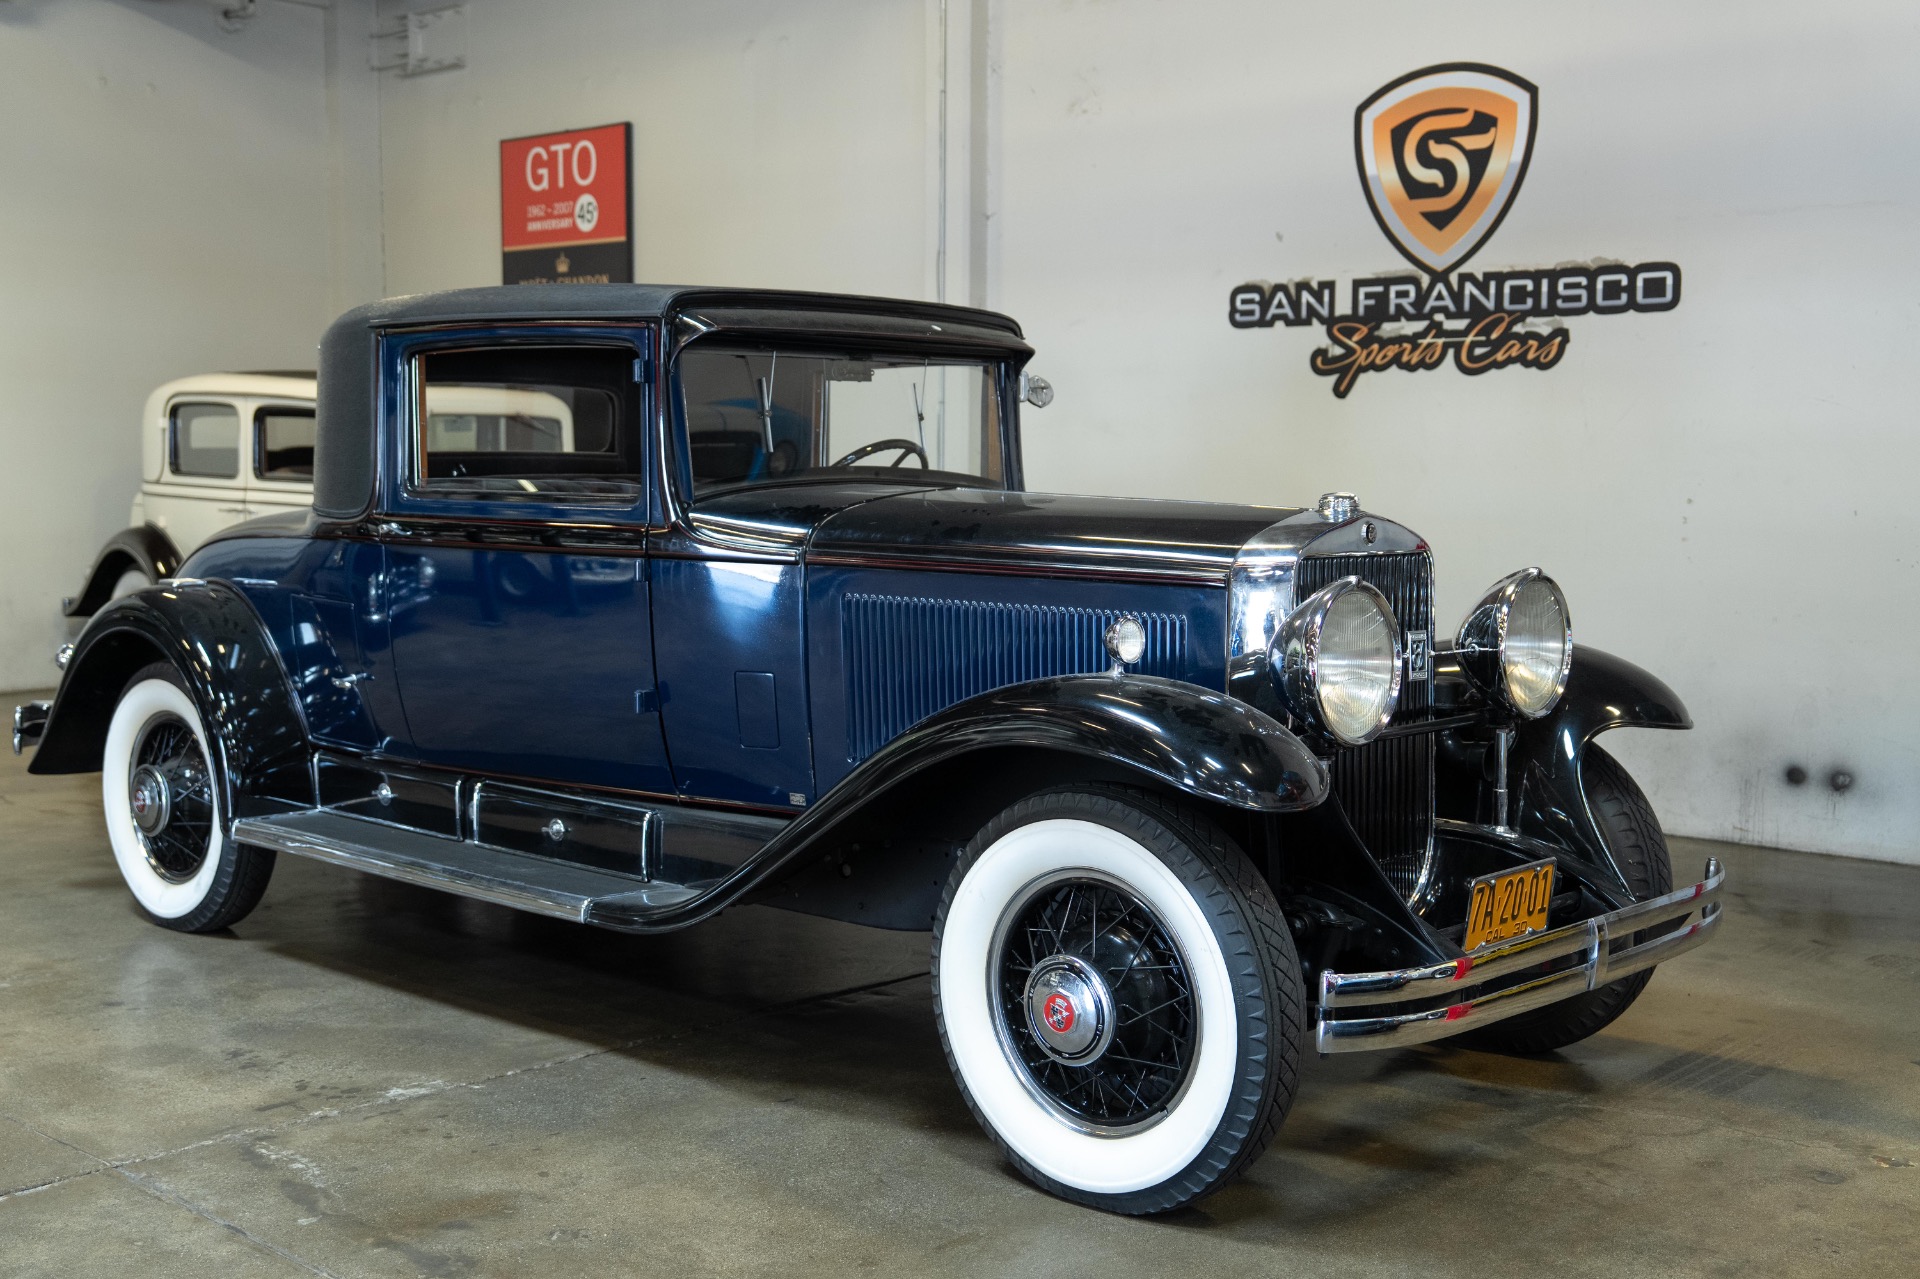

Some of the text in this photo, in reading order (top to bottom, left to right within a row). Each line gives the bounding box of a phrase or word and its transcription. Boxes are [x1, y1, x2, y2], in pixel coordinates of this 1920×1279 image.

[525, 139, 597, 192] GTO
[527, 218, 573, 232] ANNIVERSARY
[553, 201, 573, 215] 2007
[1233, 269, 1675, 323] SAN FRANCISCO
[1314, 310, 1566, 394] Sports Cars
[1486, 921, 1528, 943] CAL 30
